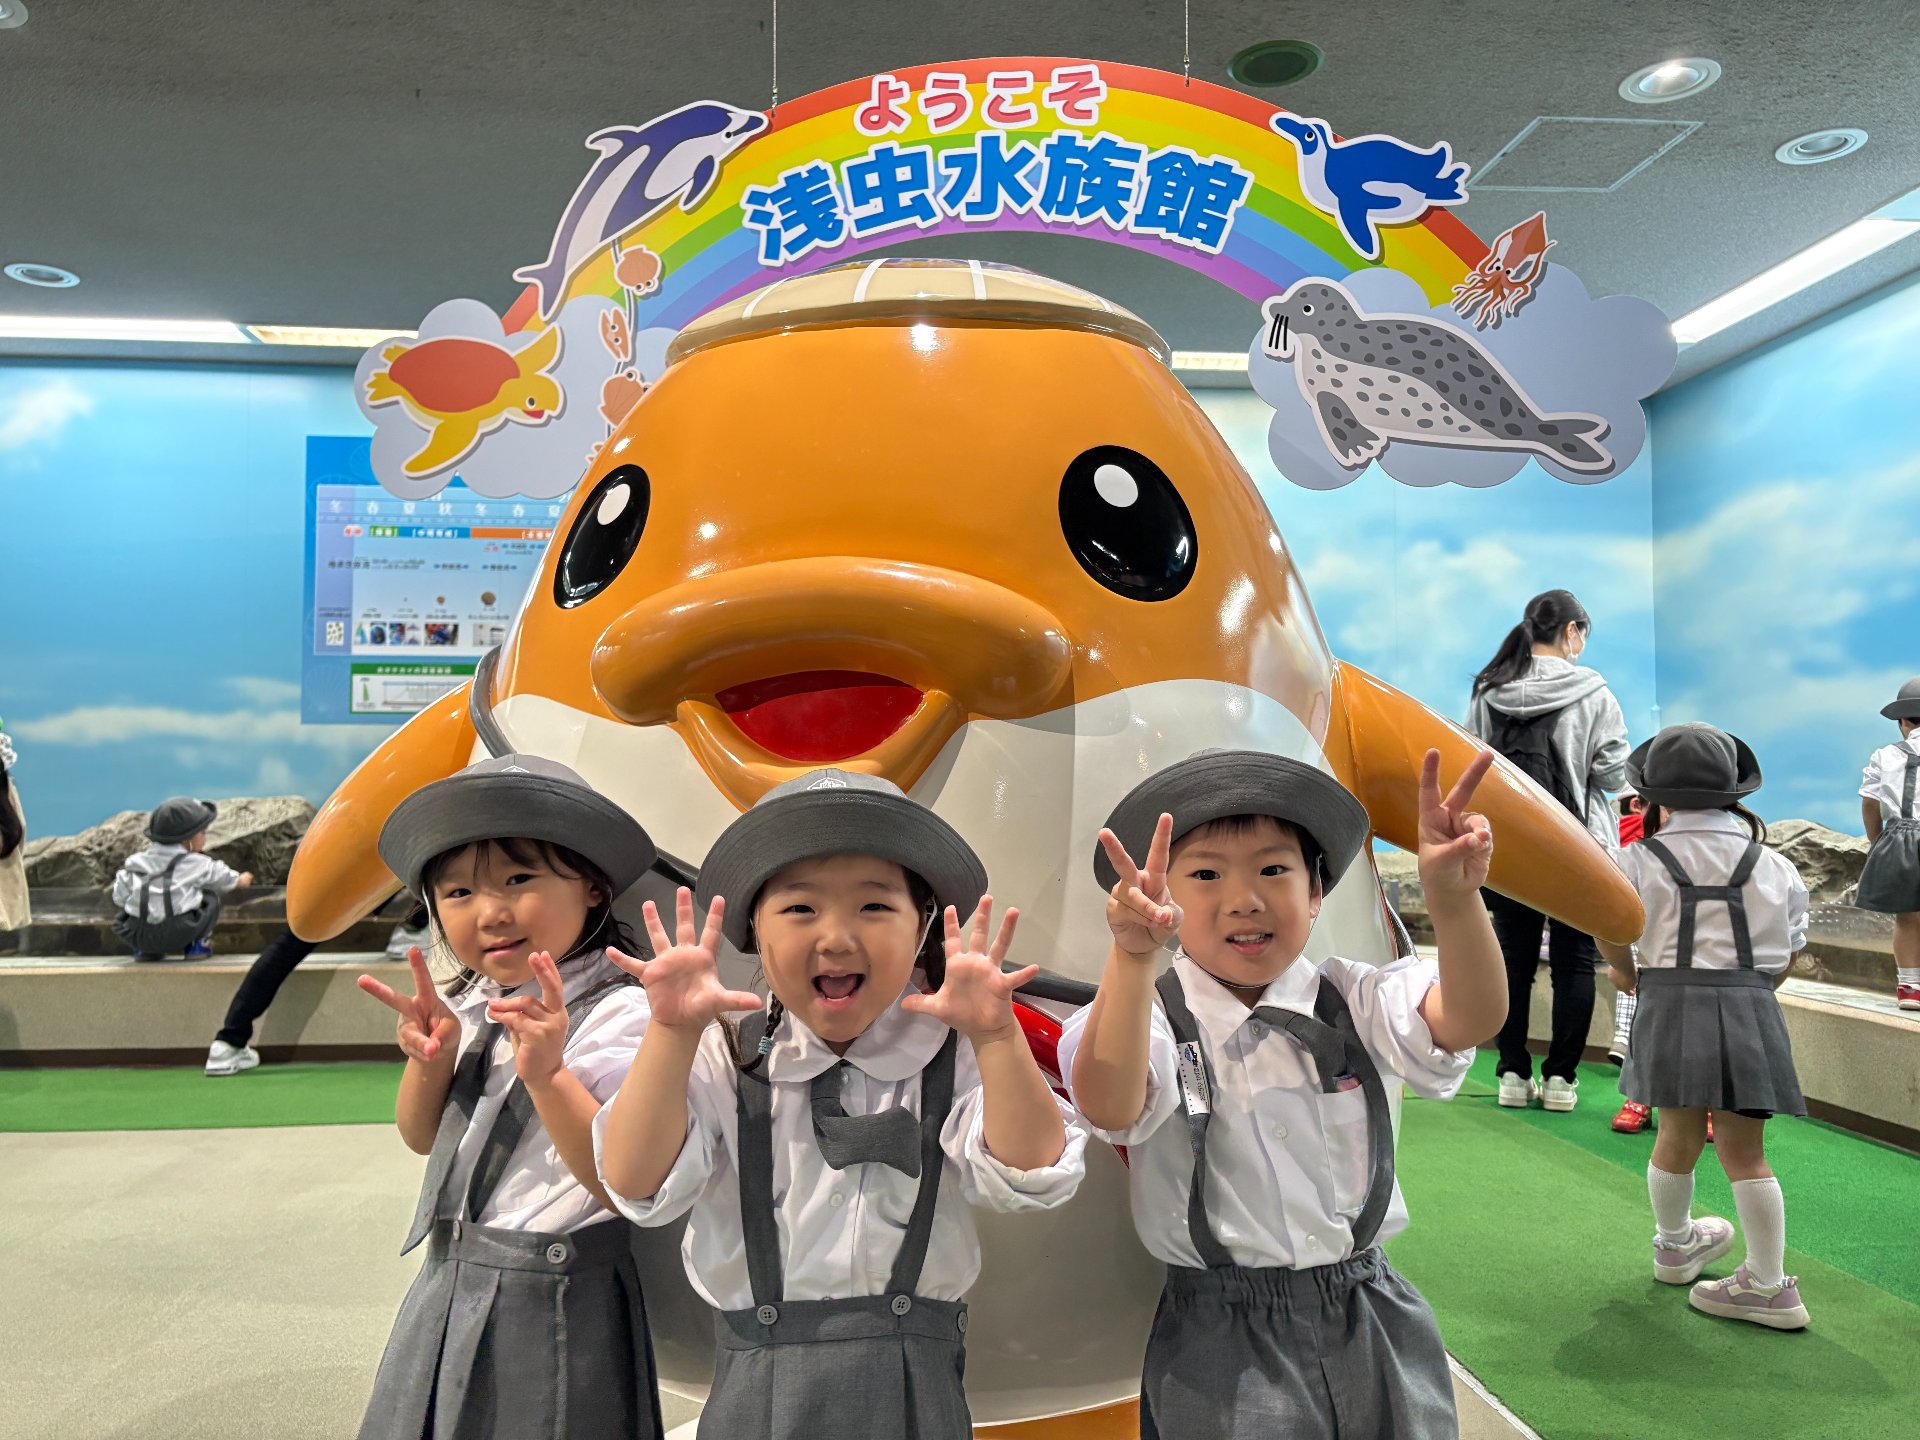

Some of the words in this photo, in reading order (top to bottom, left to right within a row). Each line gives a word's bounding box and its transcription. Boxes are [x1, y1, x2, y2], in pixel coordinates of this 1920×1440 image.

[857, 69, 1103, 131] ようこそ
[745, 134, 1250, 263] 浅虫水族館
